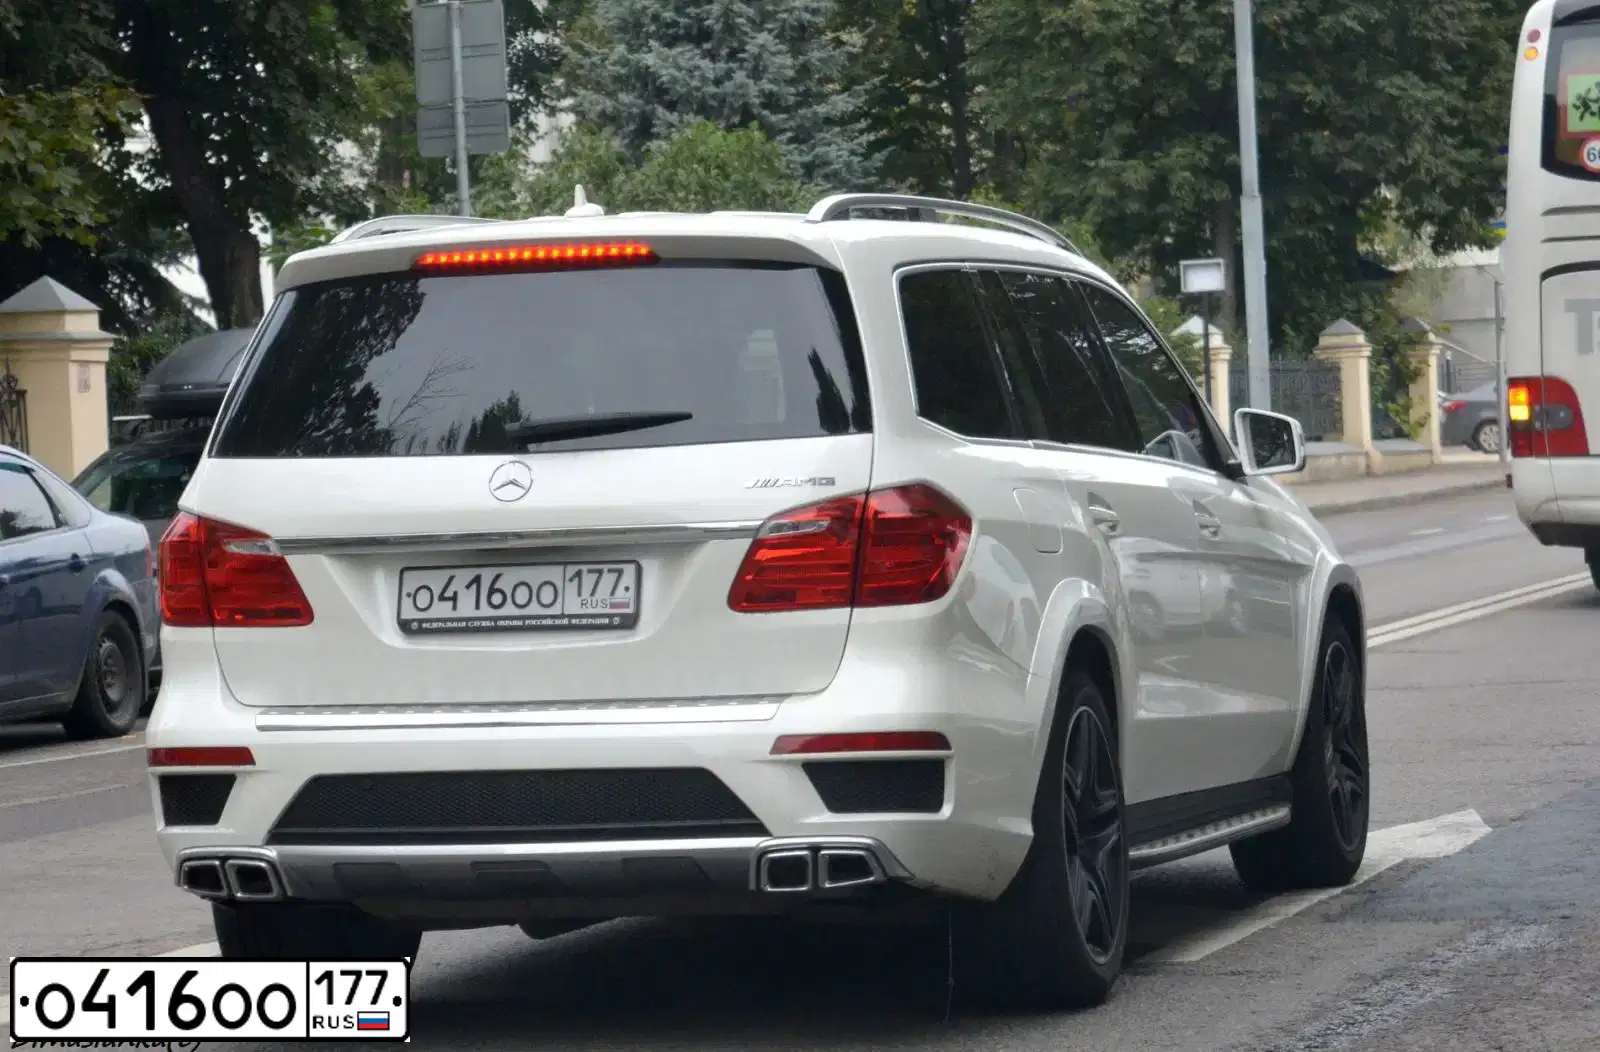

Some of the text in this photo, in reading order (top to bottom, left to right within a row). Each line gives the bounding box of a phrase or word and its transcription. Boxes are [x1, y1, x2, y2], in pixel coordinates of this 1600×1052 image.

[1564, 298, 1600, 357] T
[568, 567, 625, 598] 177
[580, 599, 609, 610] RUS
